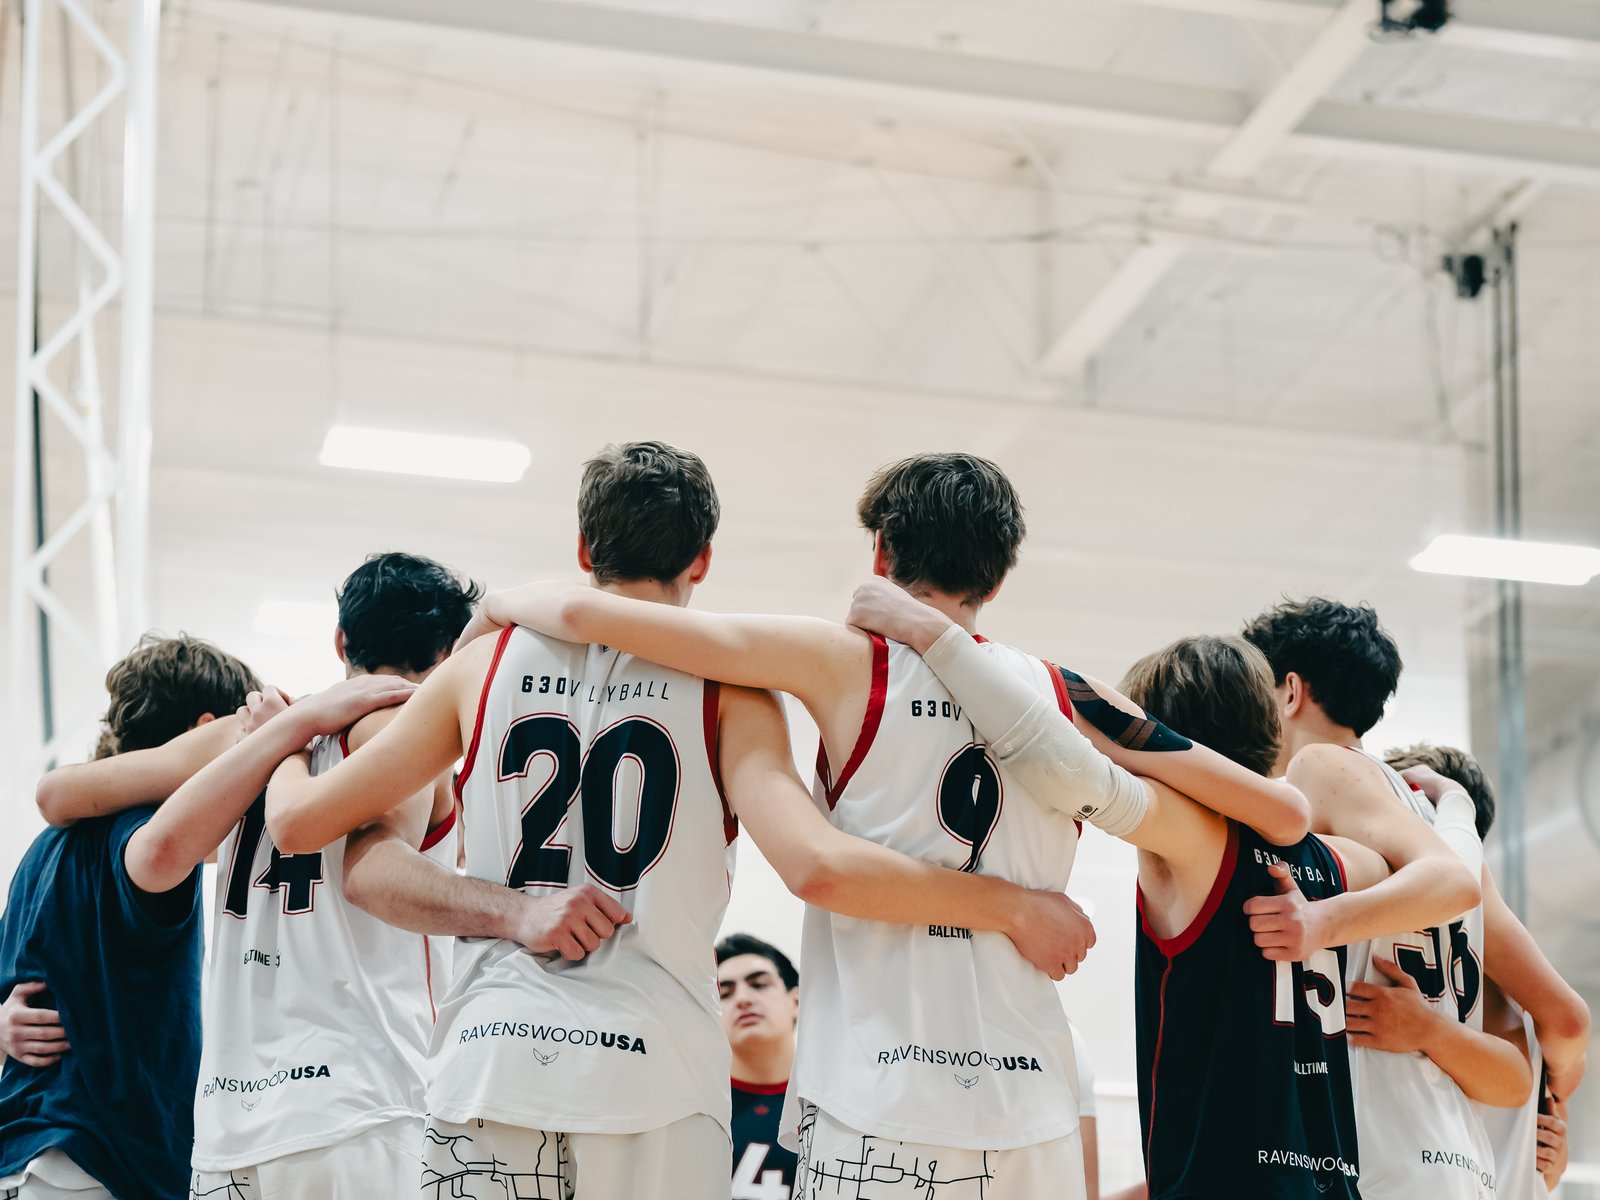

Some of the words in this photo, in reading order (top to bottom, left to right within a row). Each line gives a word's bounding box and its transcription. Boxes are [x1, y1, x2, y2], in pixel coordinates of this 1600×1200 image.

[222, 785, 325, 920] 14
[497, 711, 681, 893] 20
[459, 1021, 647, 1055] RAVENSWOODUSA
